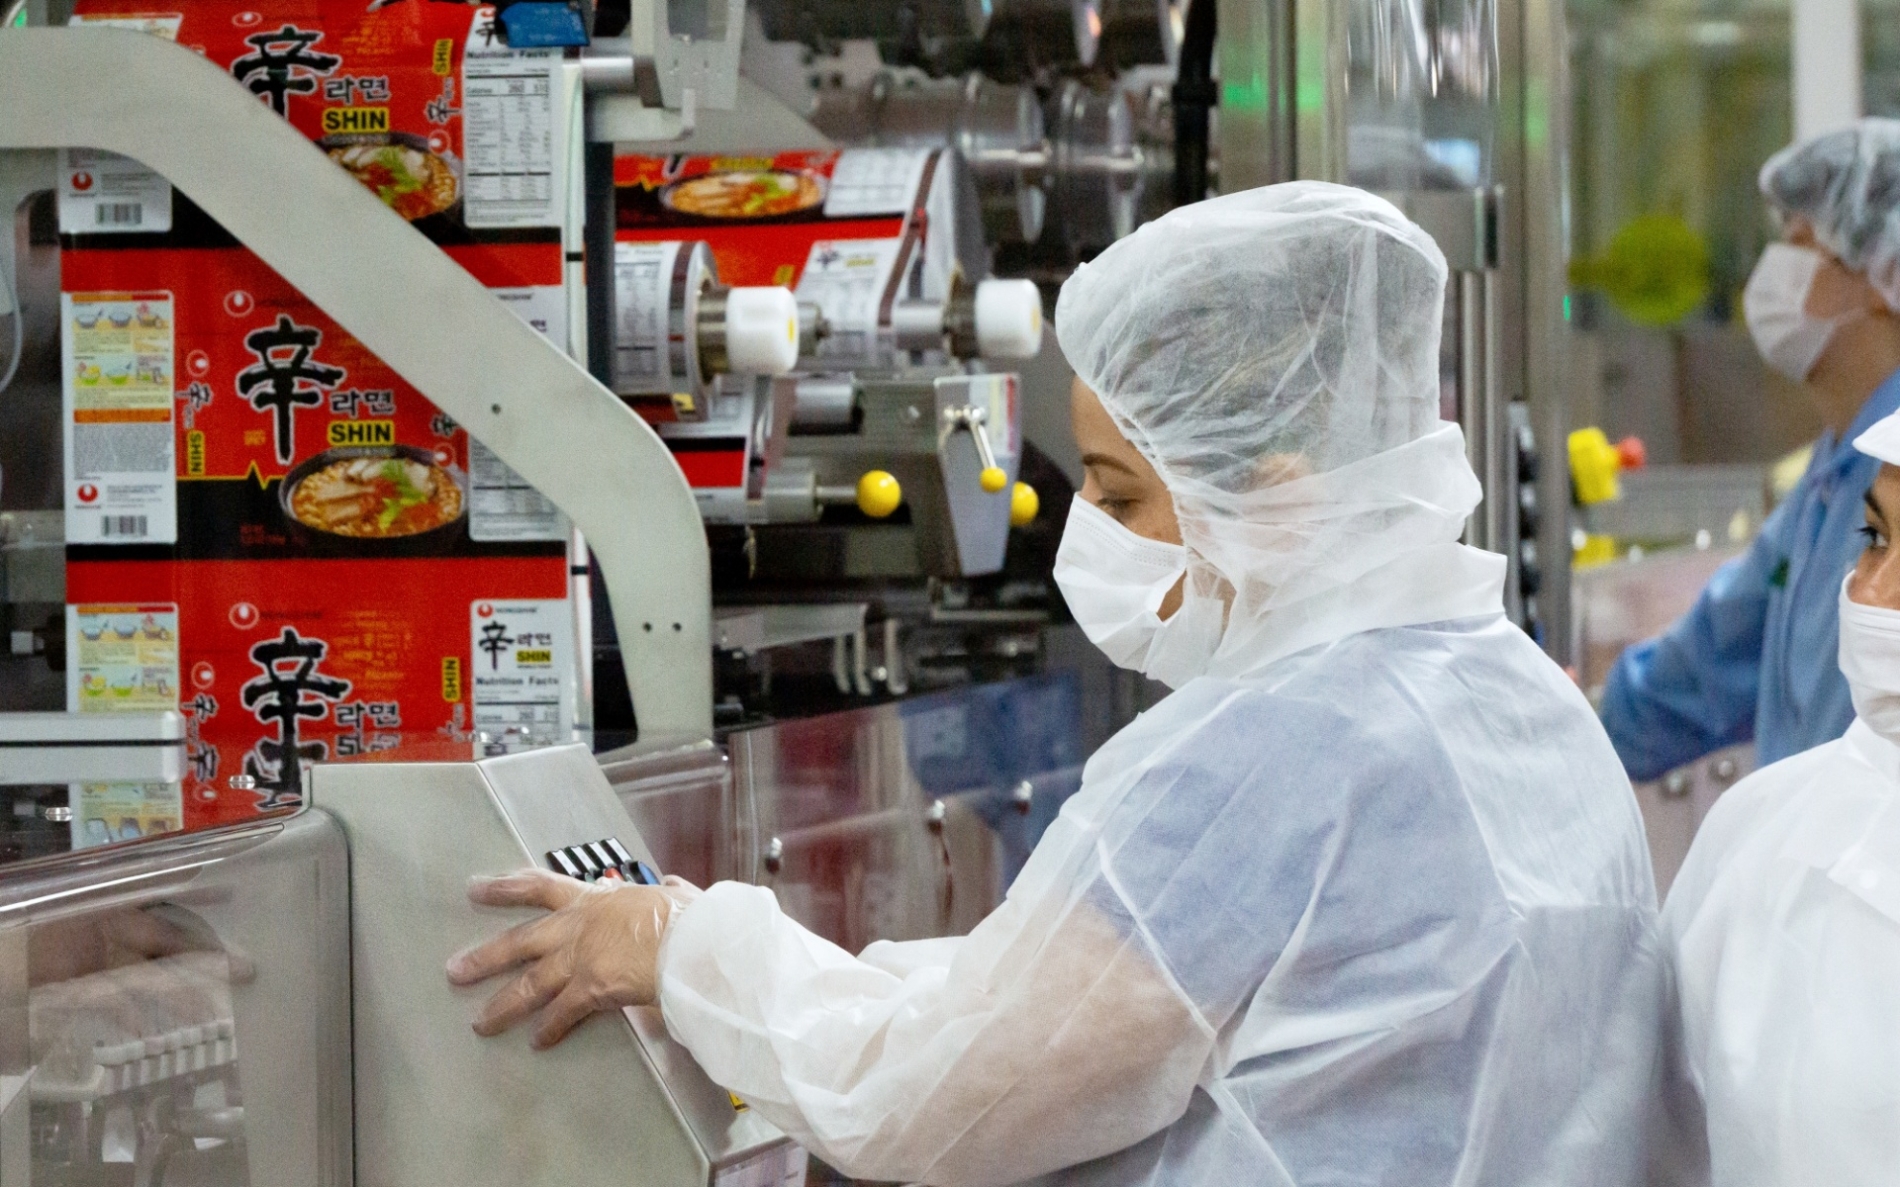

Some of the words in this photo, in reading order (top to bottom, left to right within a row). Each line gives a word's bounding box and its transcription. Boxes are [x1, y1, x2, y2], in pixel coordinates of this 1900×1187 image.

[325, 77, 390, 103] 라면
[325, 111, 386, 130] SHIN
[237, 316, 345, 461] 辛
[331, 390, 394, 416] 라면
[330, 423, 392, 443] SHIN
[190, 433, 202, 473] SHIN
[478, 620, 515, 670] 辛
[517, 651, 551, 662] SHIN
[445, 659, 458, 699] SHIN
[476, 677, 523, 685] Nutrition
[529, 676, 559, 685] Facts
[336, 702, 399, 729] 라면
